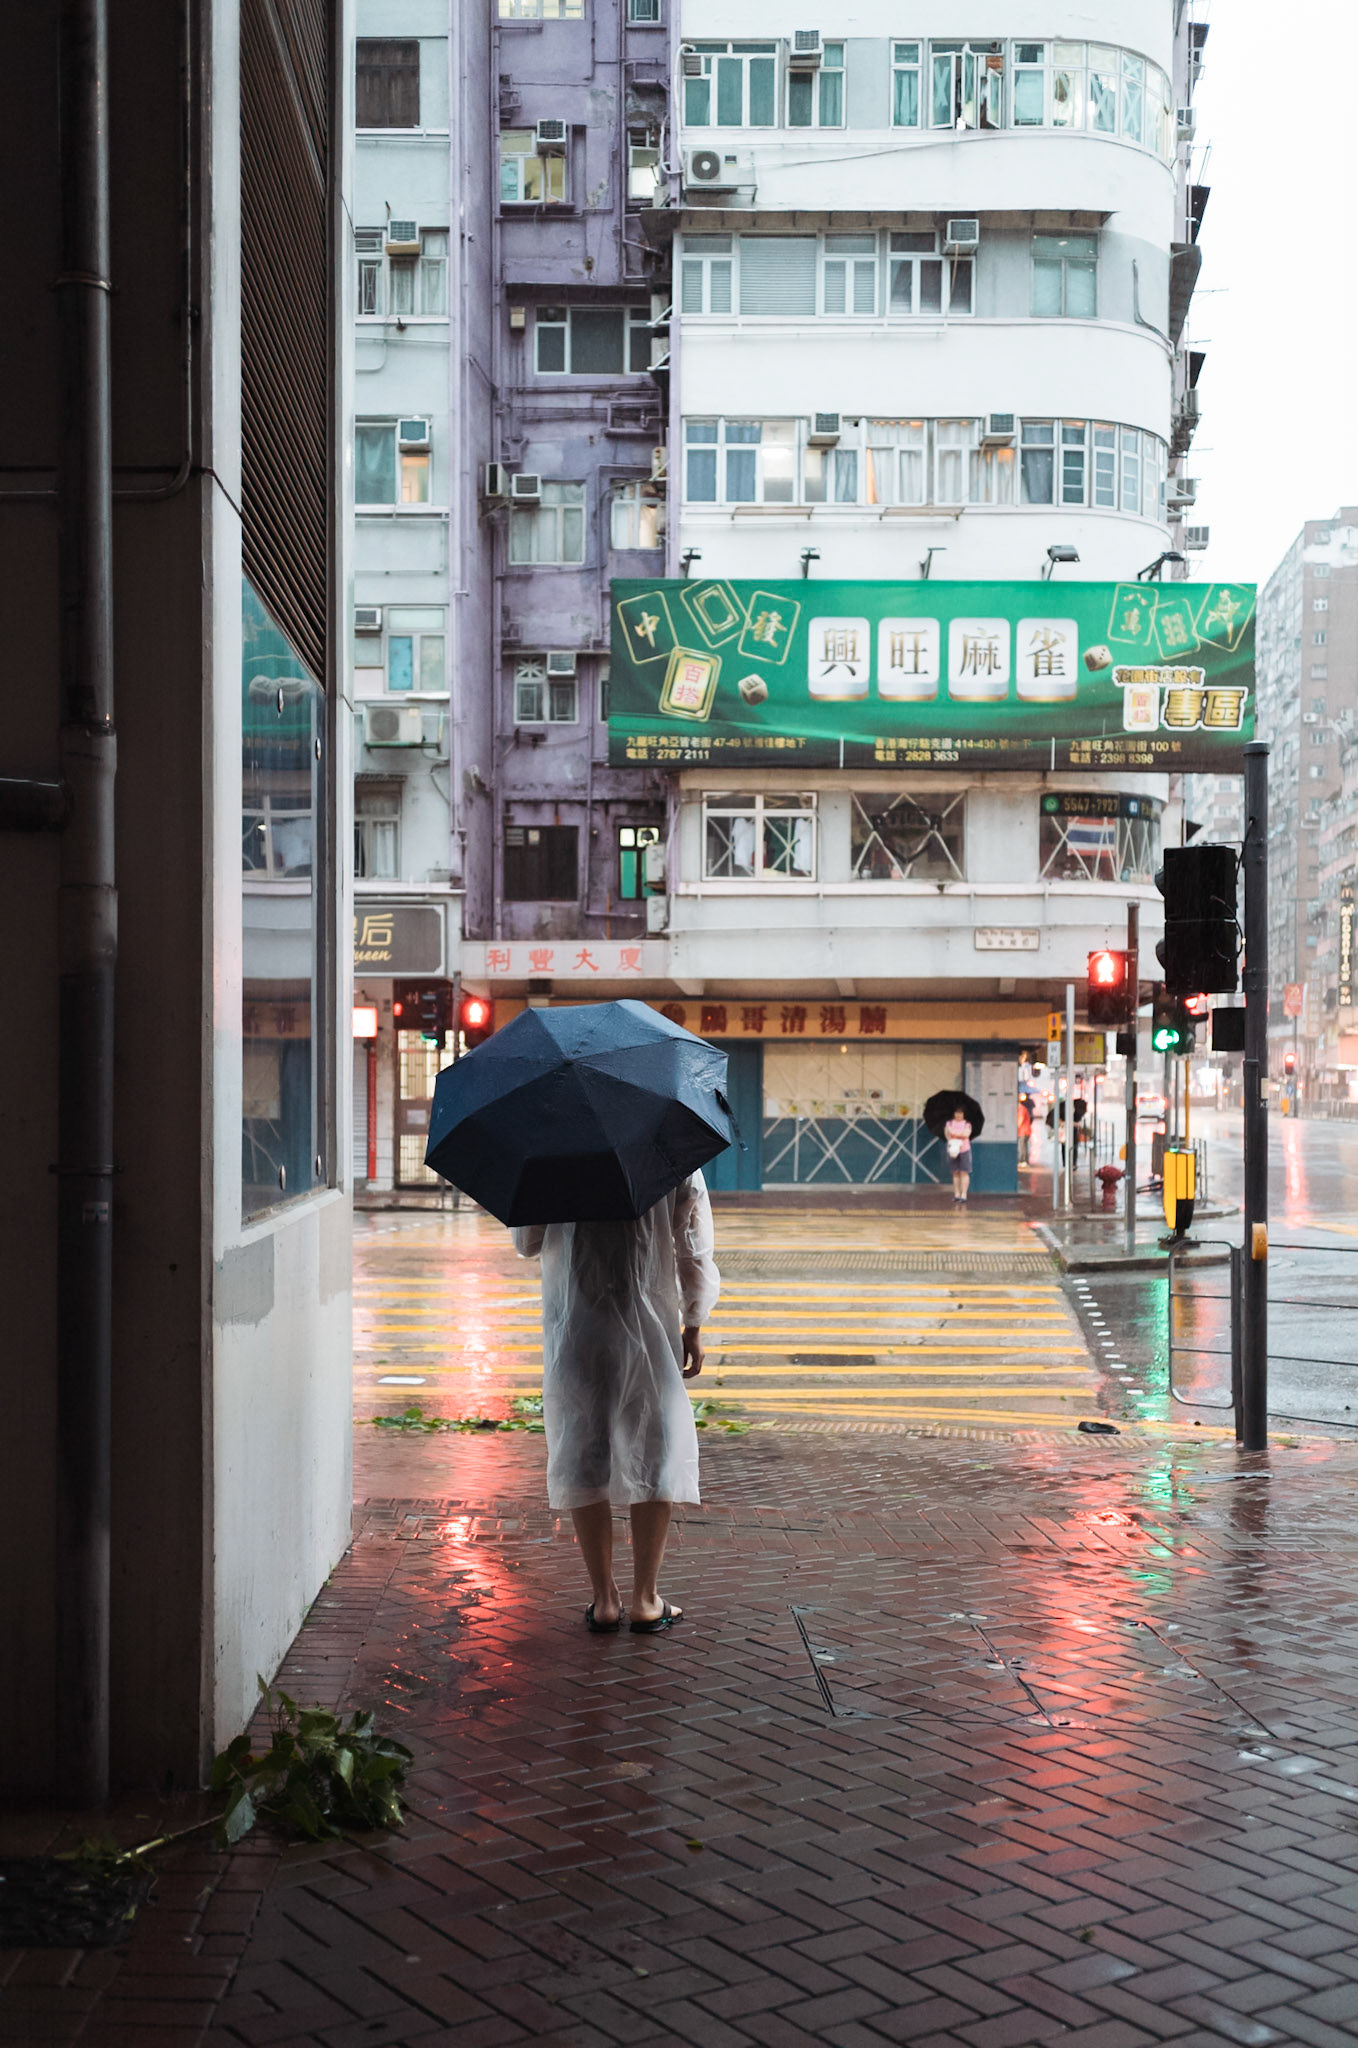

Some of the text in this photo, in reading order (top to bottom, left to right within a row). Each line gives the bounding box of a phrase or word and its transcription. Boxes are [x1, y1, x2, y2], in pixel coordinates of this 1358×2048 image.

[634, 611, 660, 648] 中
[820, 627, 1066, 678] 興旺麻雀
[713, 737, 741, 748] 47-49
[954, 738, 997, 750] 414-430
[1150, 741, 1170, 753] 100
[656, 749, 683, 760] 2787
[684, 749, 710, 760] 2111
[933, 750, 960, 762] 3633
[1100, 753, 1126, 764] 2398
[1128, 753, 1154, 765] 8398
[354, 949, 392, 967] ueen
[485, 947, 642, 973] 利豐大廈
